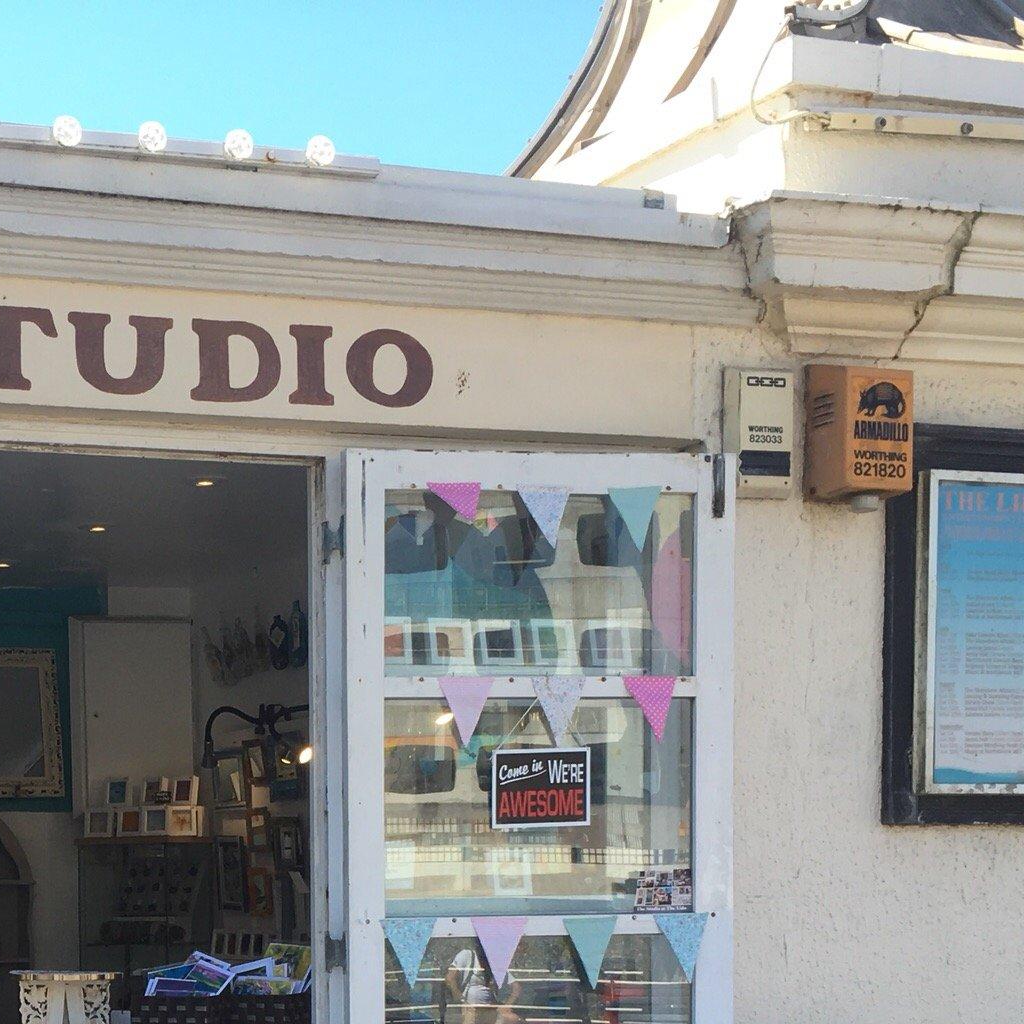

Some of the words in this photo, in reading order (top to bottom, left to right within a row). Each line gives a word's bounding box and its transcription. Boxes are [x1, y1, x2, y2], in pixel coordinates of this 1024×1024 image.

[748, 425, 784, 434] WORTHING
[853, 420, 909, 442] ARMADILLO
[749, 434, 783, 444] 823033
[853, 450, 908, 463] WORTHING
[853, 461, 906, 478] 821820
[499, 764, 530, 781] Come
[531, 759, 544, 772] in
[547, 759, 584, 784] WE'RE
[499, 788, 584, 818] AWESOME
